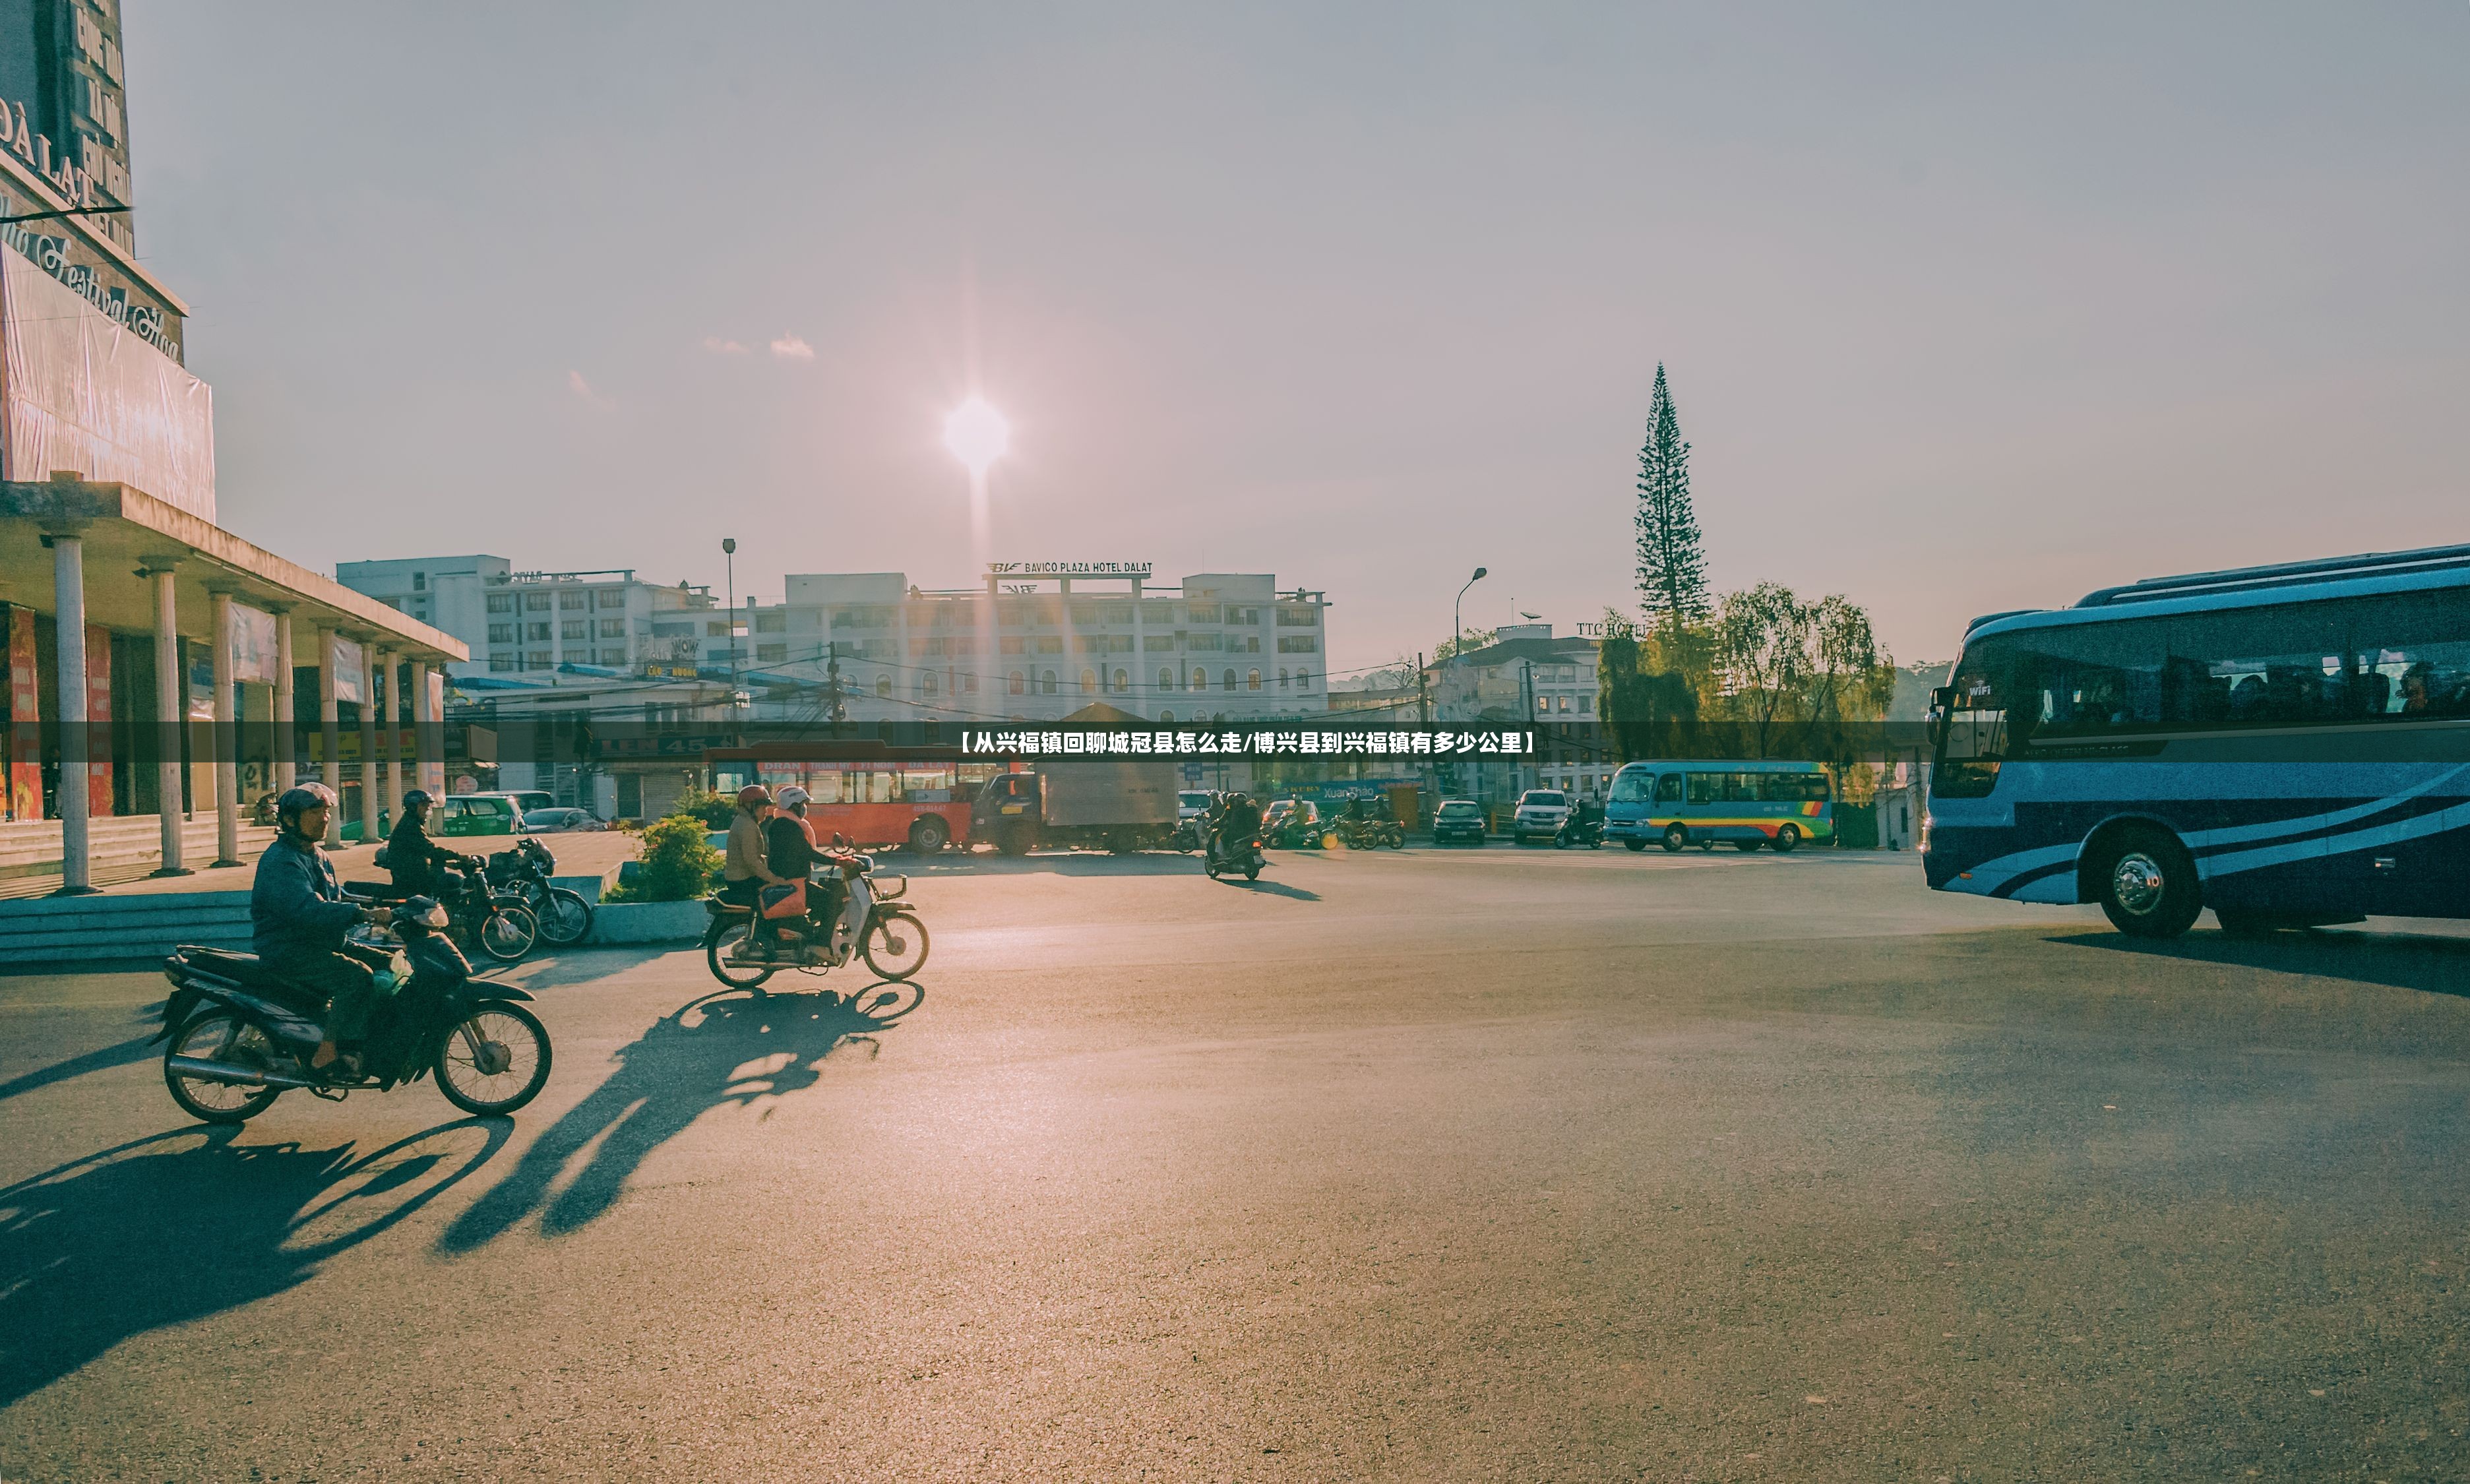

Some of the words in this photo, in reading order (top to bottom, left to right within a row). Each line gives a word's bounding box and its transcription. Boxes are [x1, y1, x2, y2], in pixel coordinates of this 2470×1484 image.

[37, 235, 129, 328] Festival
[1025, 562, 1057, 572] BAVICO
[1061, 562, 1090, 572] PLAZA
[1093, 562, 1122, 572] HOTEL
[1125, 562, 1153, 572] DALAT
[1576, 622, 1602, 635] TTC
[665, 738, 708, 753] 45
